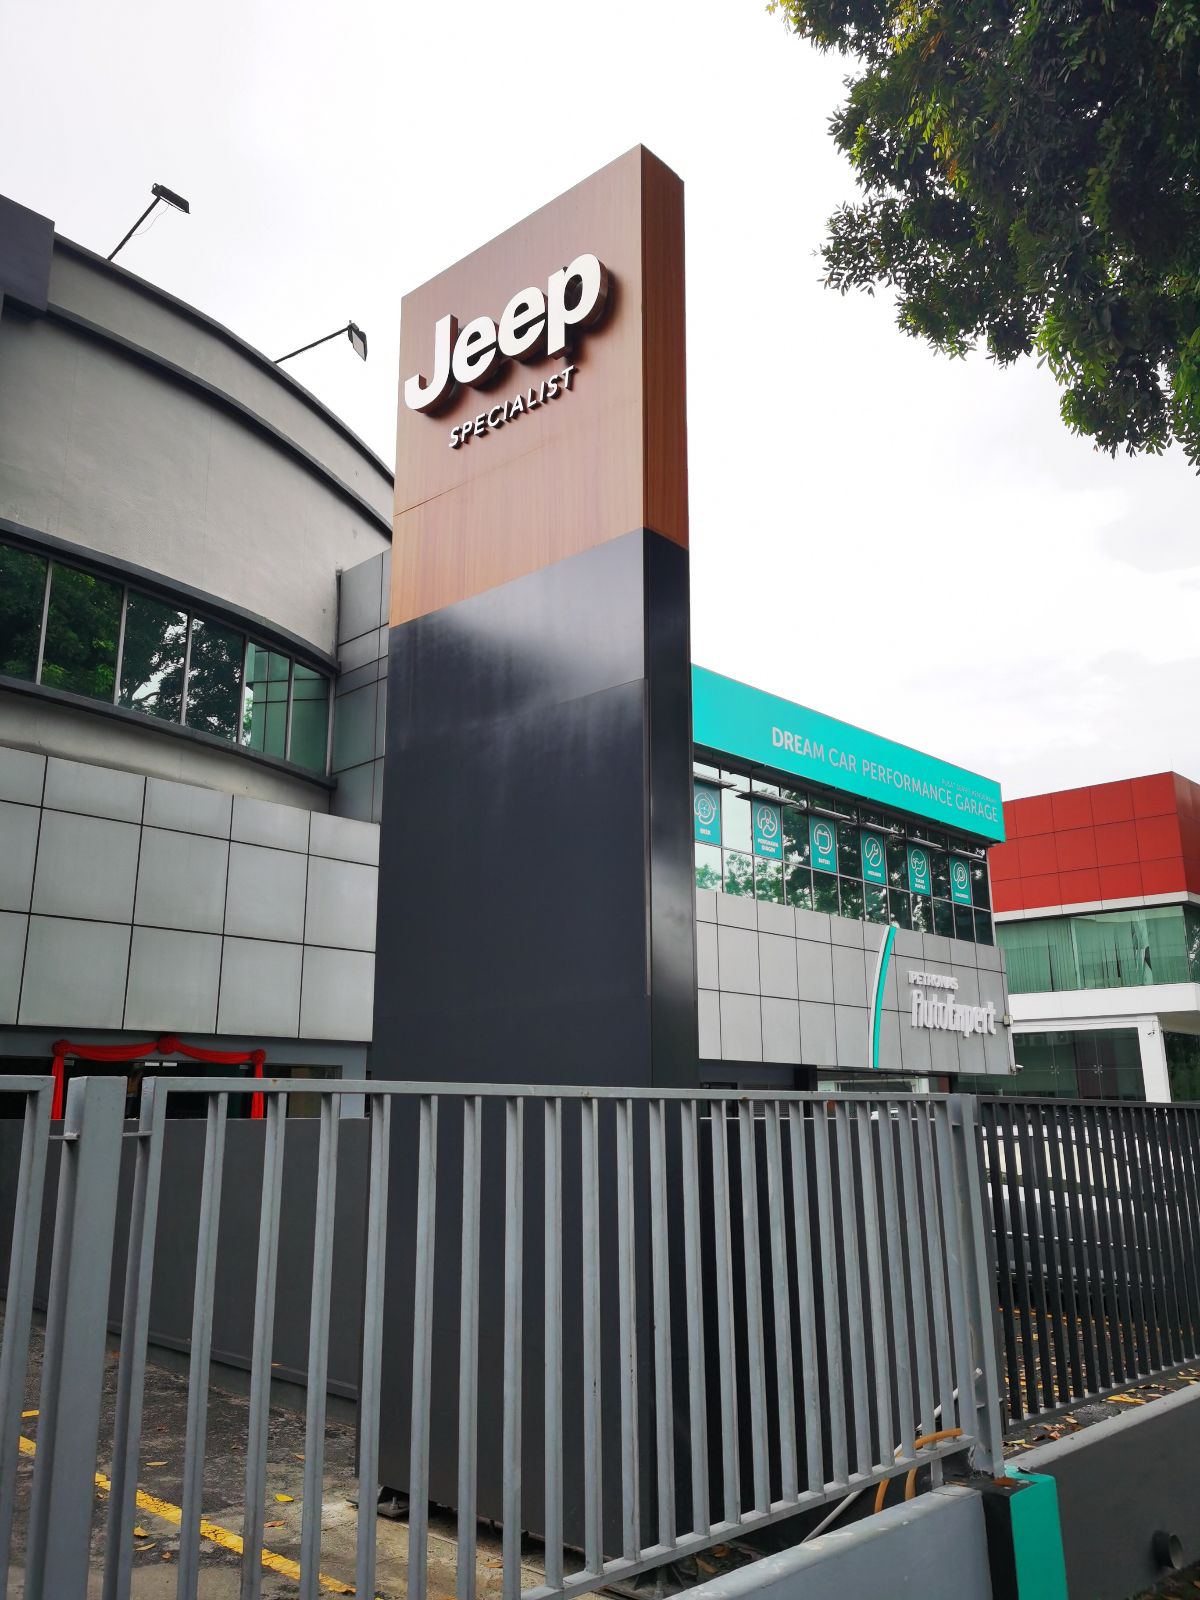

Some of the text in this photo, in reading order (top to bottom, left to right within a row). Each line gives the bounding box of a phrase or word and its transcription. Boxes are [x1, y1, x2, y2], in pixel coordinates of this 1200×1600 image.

[404, 253, 605, 411] Jeep
[449, 365, 576, 448] SPECIALIST
[772, 726, 825, 763] DREAM
[828, 747, 857, 773] CAR
[862, 759, 953, 807] PERFORMANCE
[955, 793, 999, 823] GARAGE
[908, 970, 959, 990] PETRONAS
[911, 989, 997, 1038] AutoExpert
